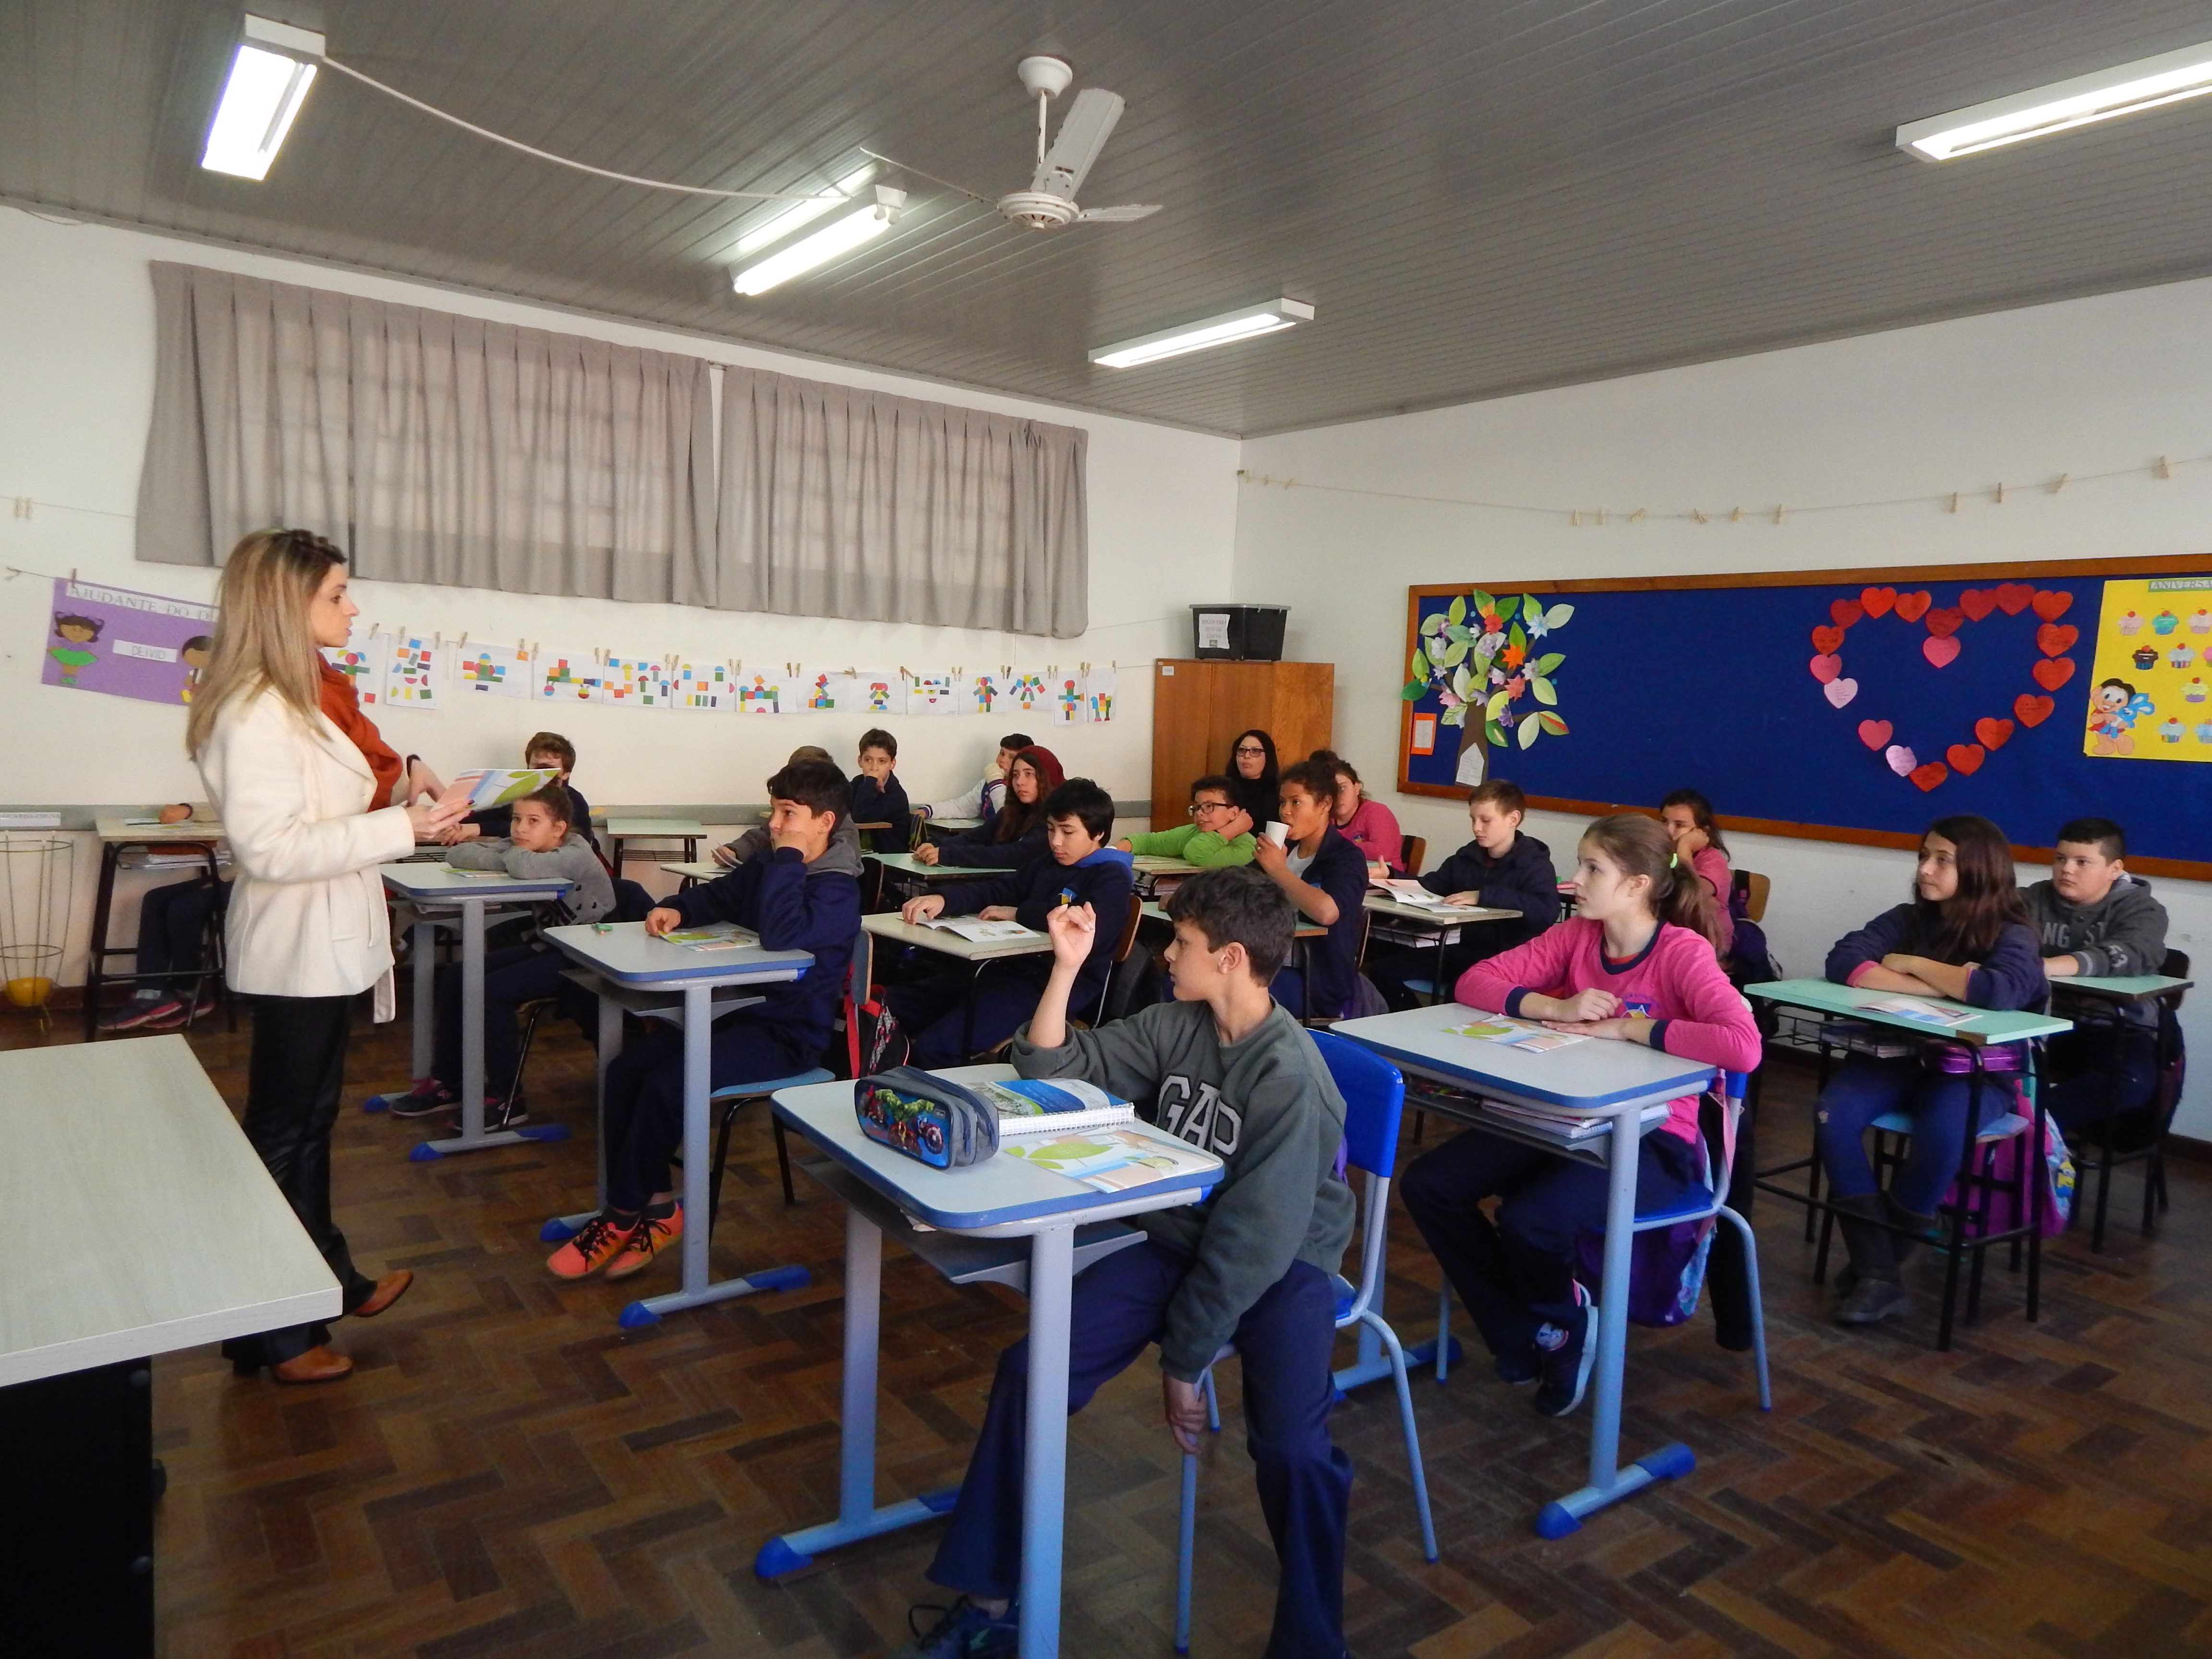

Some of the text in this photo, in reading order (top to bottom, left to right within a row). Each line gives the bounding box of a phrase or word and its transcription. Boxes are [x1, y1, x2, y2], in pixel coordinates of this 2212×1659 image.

[71, 587, 157, 612] AJUDANTE
[167, 604, 189, 617] DO
[1155, 1074, 1242, 1156] GAP
